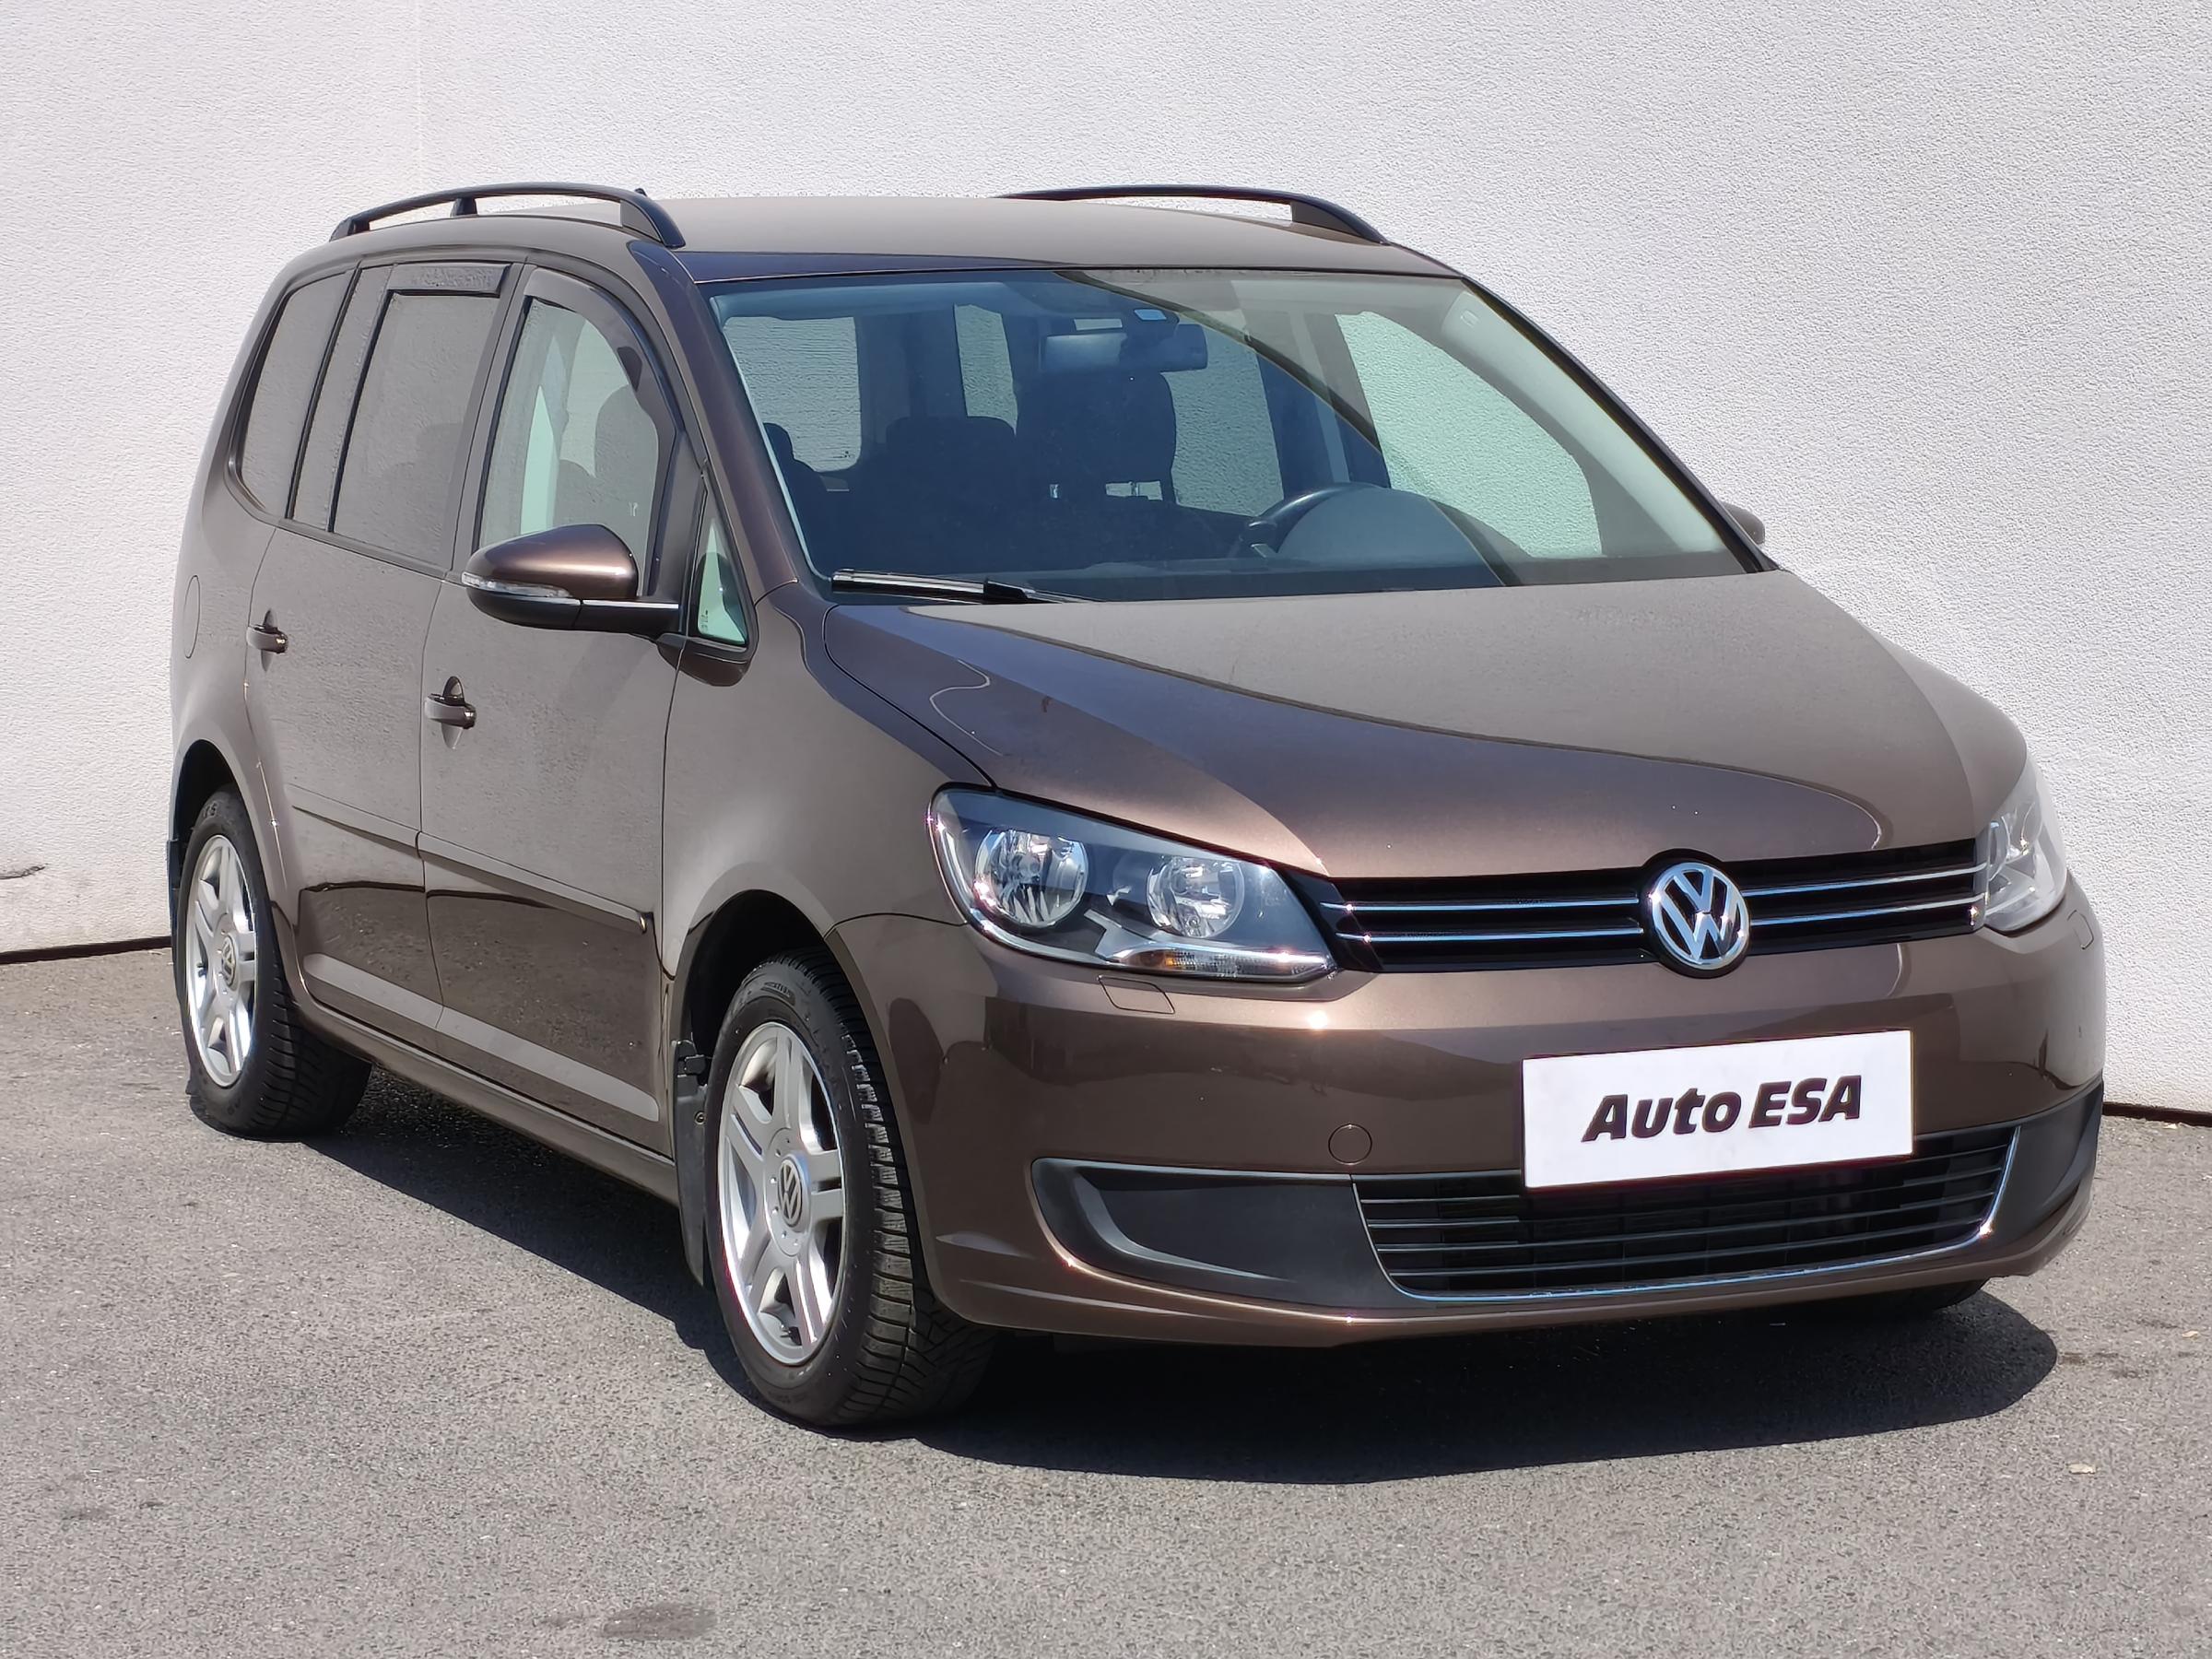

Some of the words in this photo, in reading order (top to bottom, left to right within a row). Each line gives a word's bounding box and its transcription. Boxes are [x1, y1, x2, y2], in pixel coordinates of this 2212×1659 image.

[1653, 862, 1750, 970] VW
[1581, 1088, 1742, 1142] Auto
[1748, 1075, 1862, 1128] ESA
[778, 1159, 803, 1227] VW
